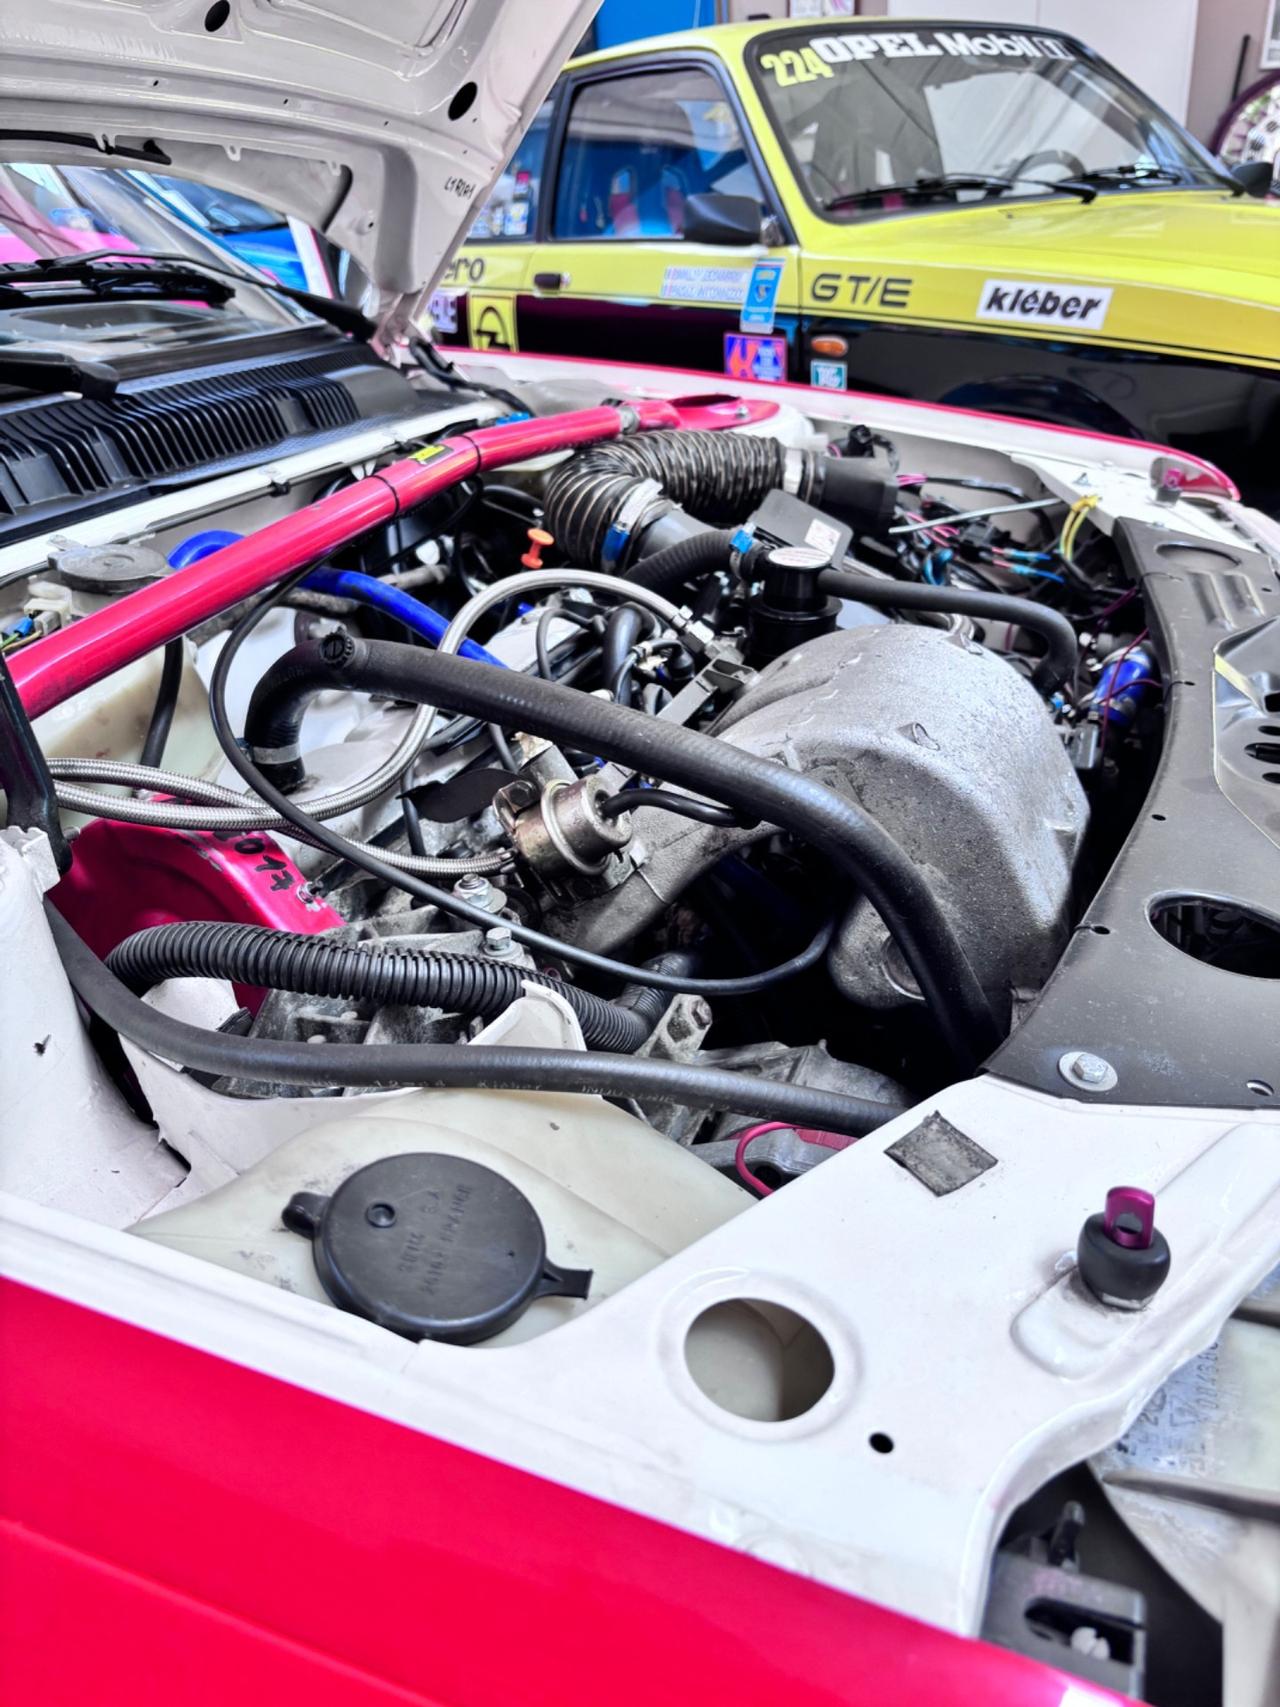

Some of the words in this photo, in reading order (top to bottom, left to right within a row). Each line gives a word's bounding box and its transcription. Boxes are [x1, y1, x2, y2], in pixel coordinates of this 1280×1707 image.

[809, 32, 945, 63] OPEL
[933, 32, 1043, 58] Mobil
[760, 47, 835, 87] 224
[810, 272, 912, 309] GT/E
[984, 286, 1103, 321] kléber
